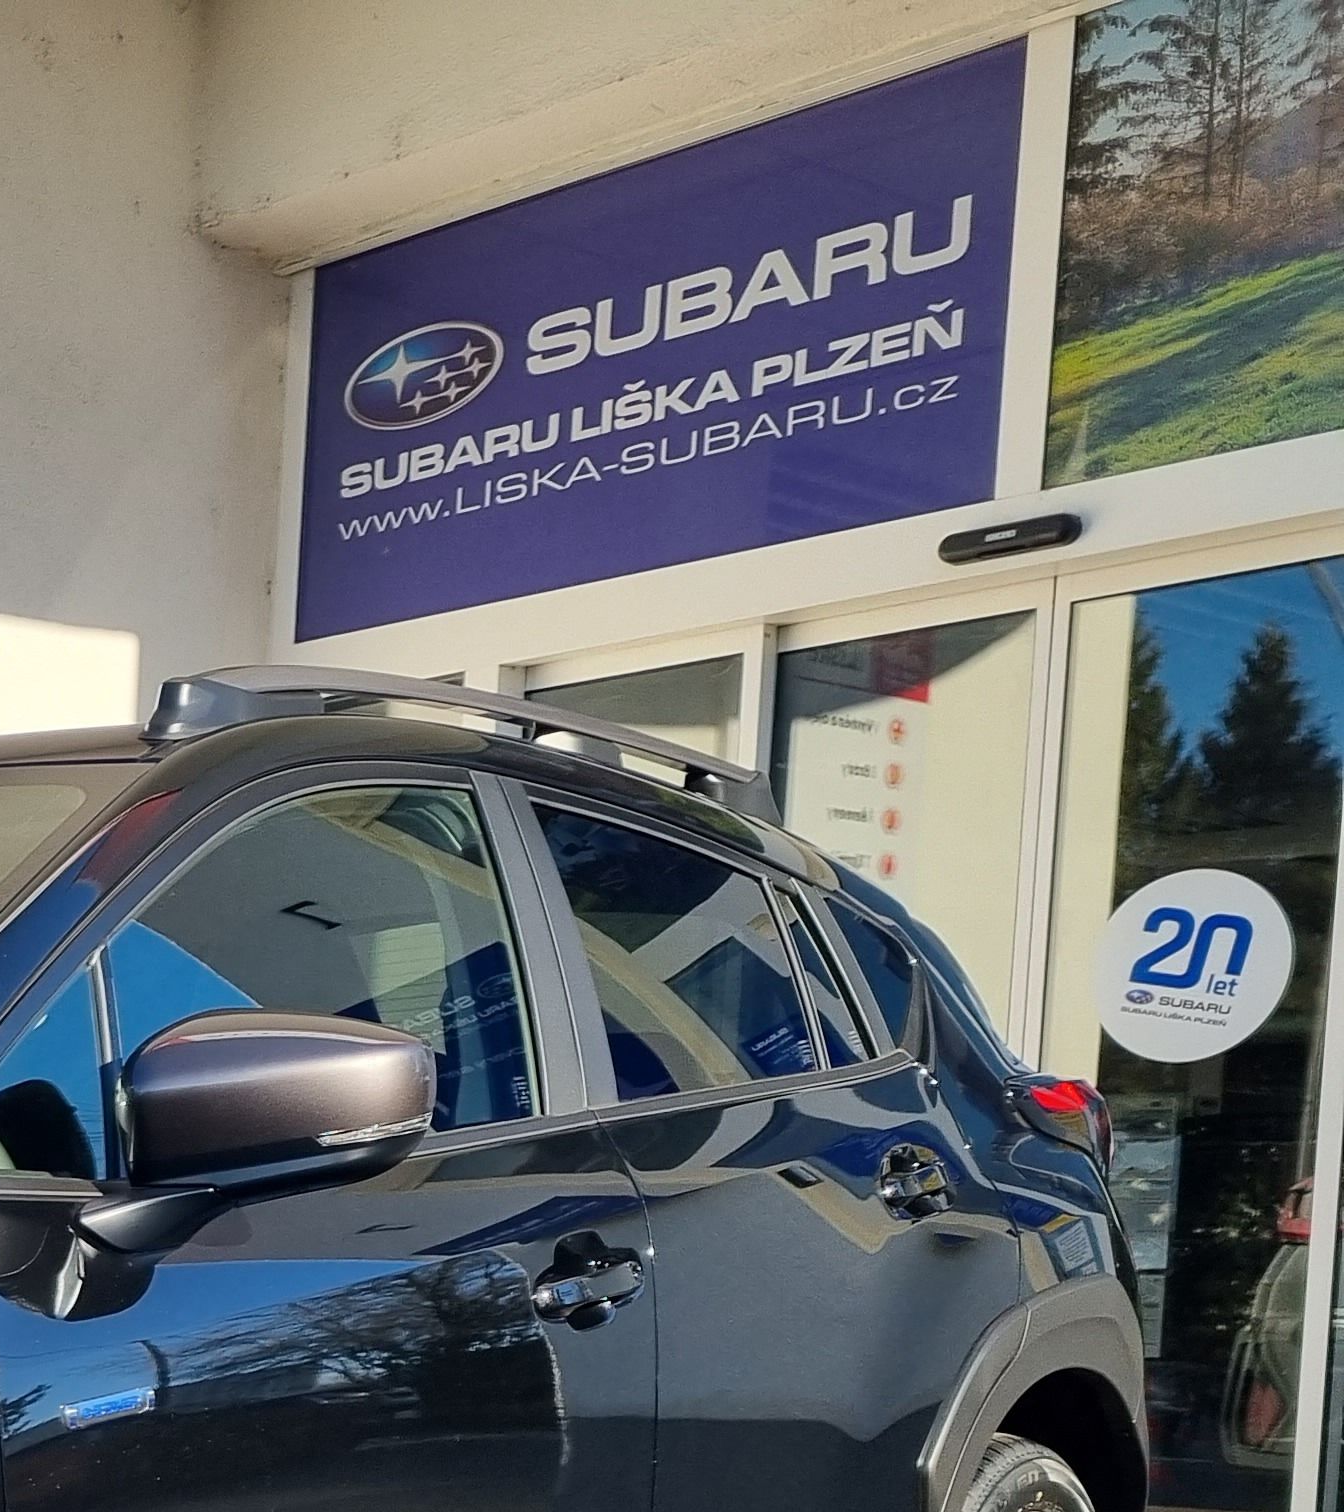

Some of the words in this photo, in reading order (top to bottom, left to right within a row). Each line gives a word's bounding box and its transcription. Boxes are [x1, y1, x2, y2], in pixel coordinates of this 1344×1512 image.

[526, 194, 973, 376] SUBARU
[339, 412, 561, 499] SUBARU
[569, 369, 741, 443] LIŠKA
[750, 298, 965, 398] PLZEŇ
[1128, 906, 1254, 989] 20
[1120, 1005, 1162, 1018] SUBARU
[1158, 995, 1232, 1015] SUBARU
[1205, 974, 1239, 997] let
